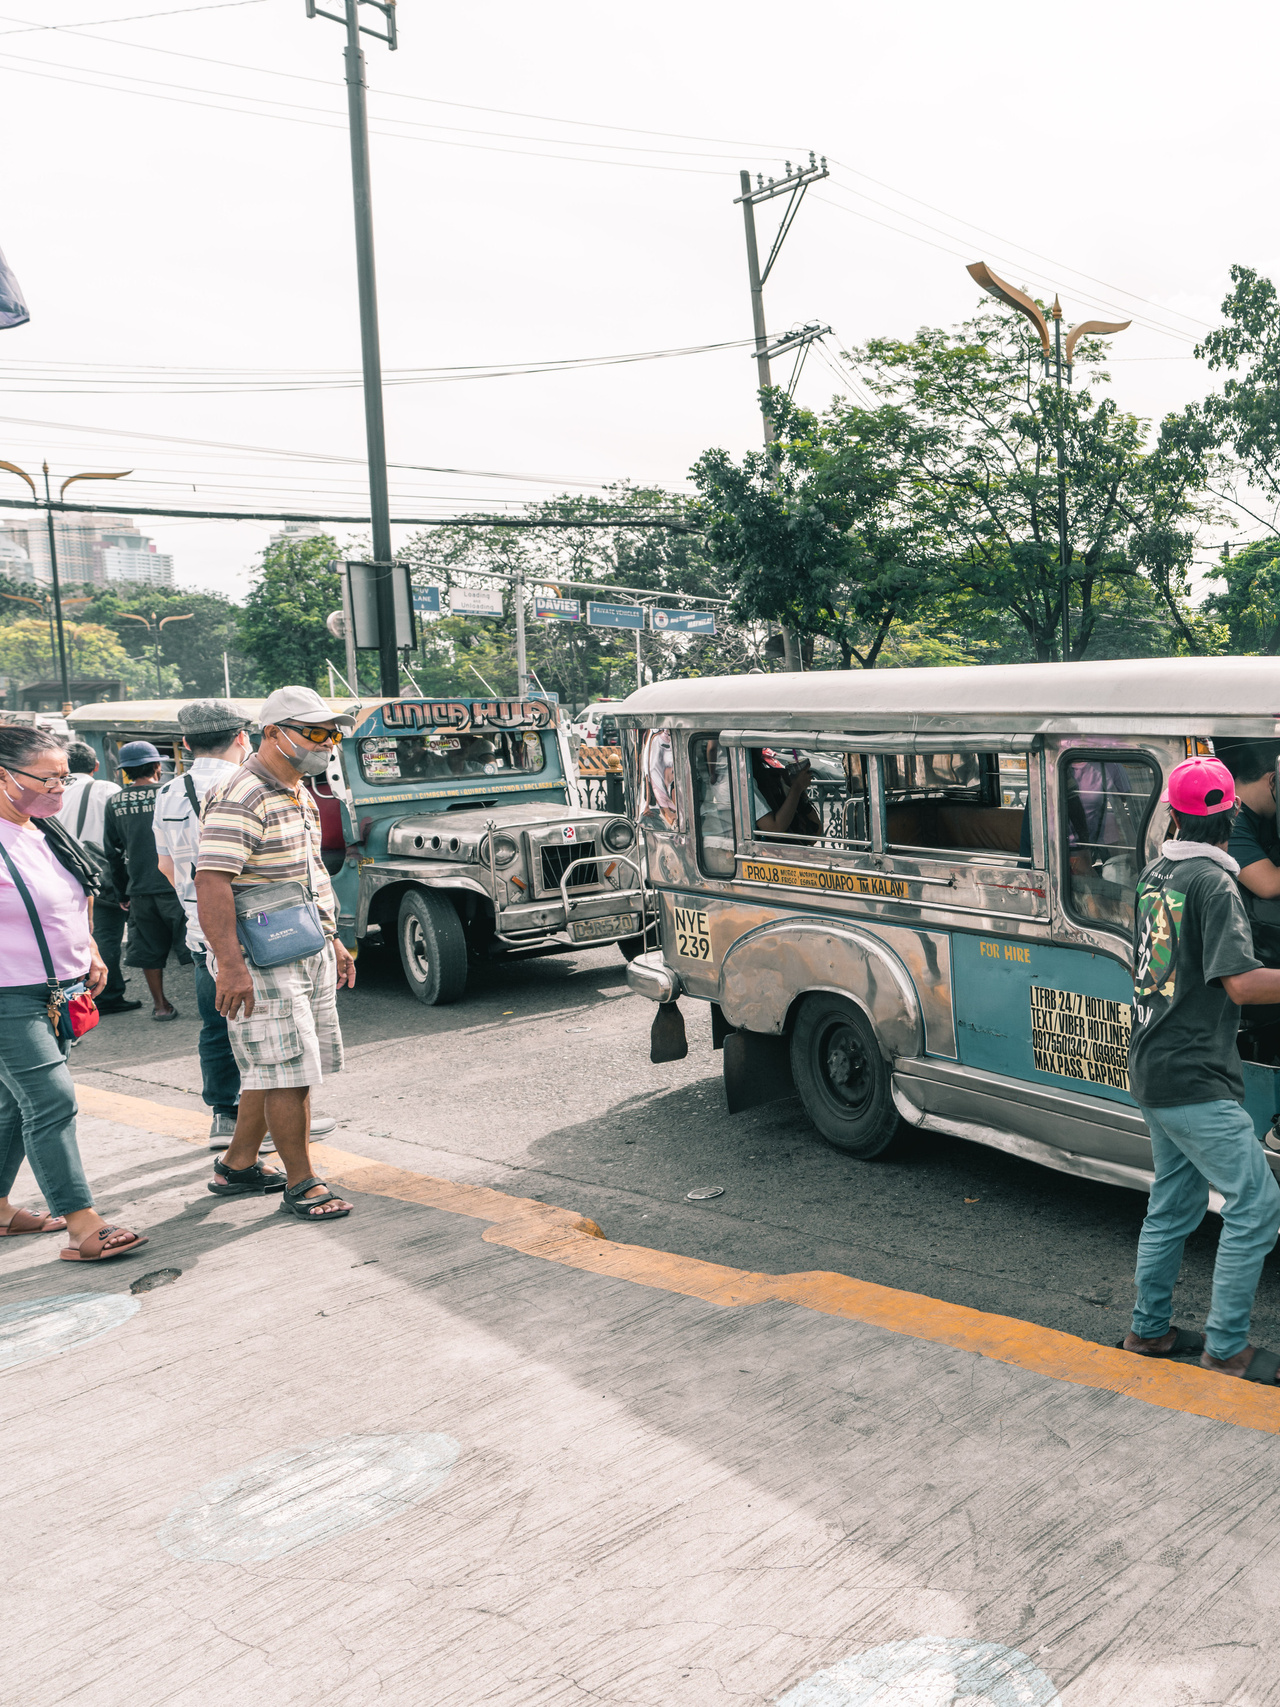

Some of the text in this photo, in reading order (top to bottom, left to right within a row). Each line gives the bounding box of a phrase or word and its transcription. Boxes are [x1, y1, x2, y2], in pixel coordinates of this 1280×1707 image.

[463, 591, 490, 600] Loading
[536, 598, 578, 611] DAVIES
[461, 602, 494, 611] Unloading
[593, 606, 640, 617] PRIVATE VEHICLES
[130, 806, 140, 814] IT
[746, 864, 780, 883] PROJ.8
[870, 878, 904, 897] KALAW
[675, 908, 710, 936] NYE
[678, 933, 710, 960] 239
[979, 941, 1032, 964] FOR HIRE
[1030, 985, 1057, 1010] LTFRB
[1059, 991, 1083, 1015] 24/7
[1085, 995, 1122, 1025] HOTLINE
[1031, 1007, 1131, 1048] TEXT/VIBER HOTLINES
